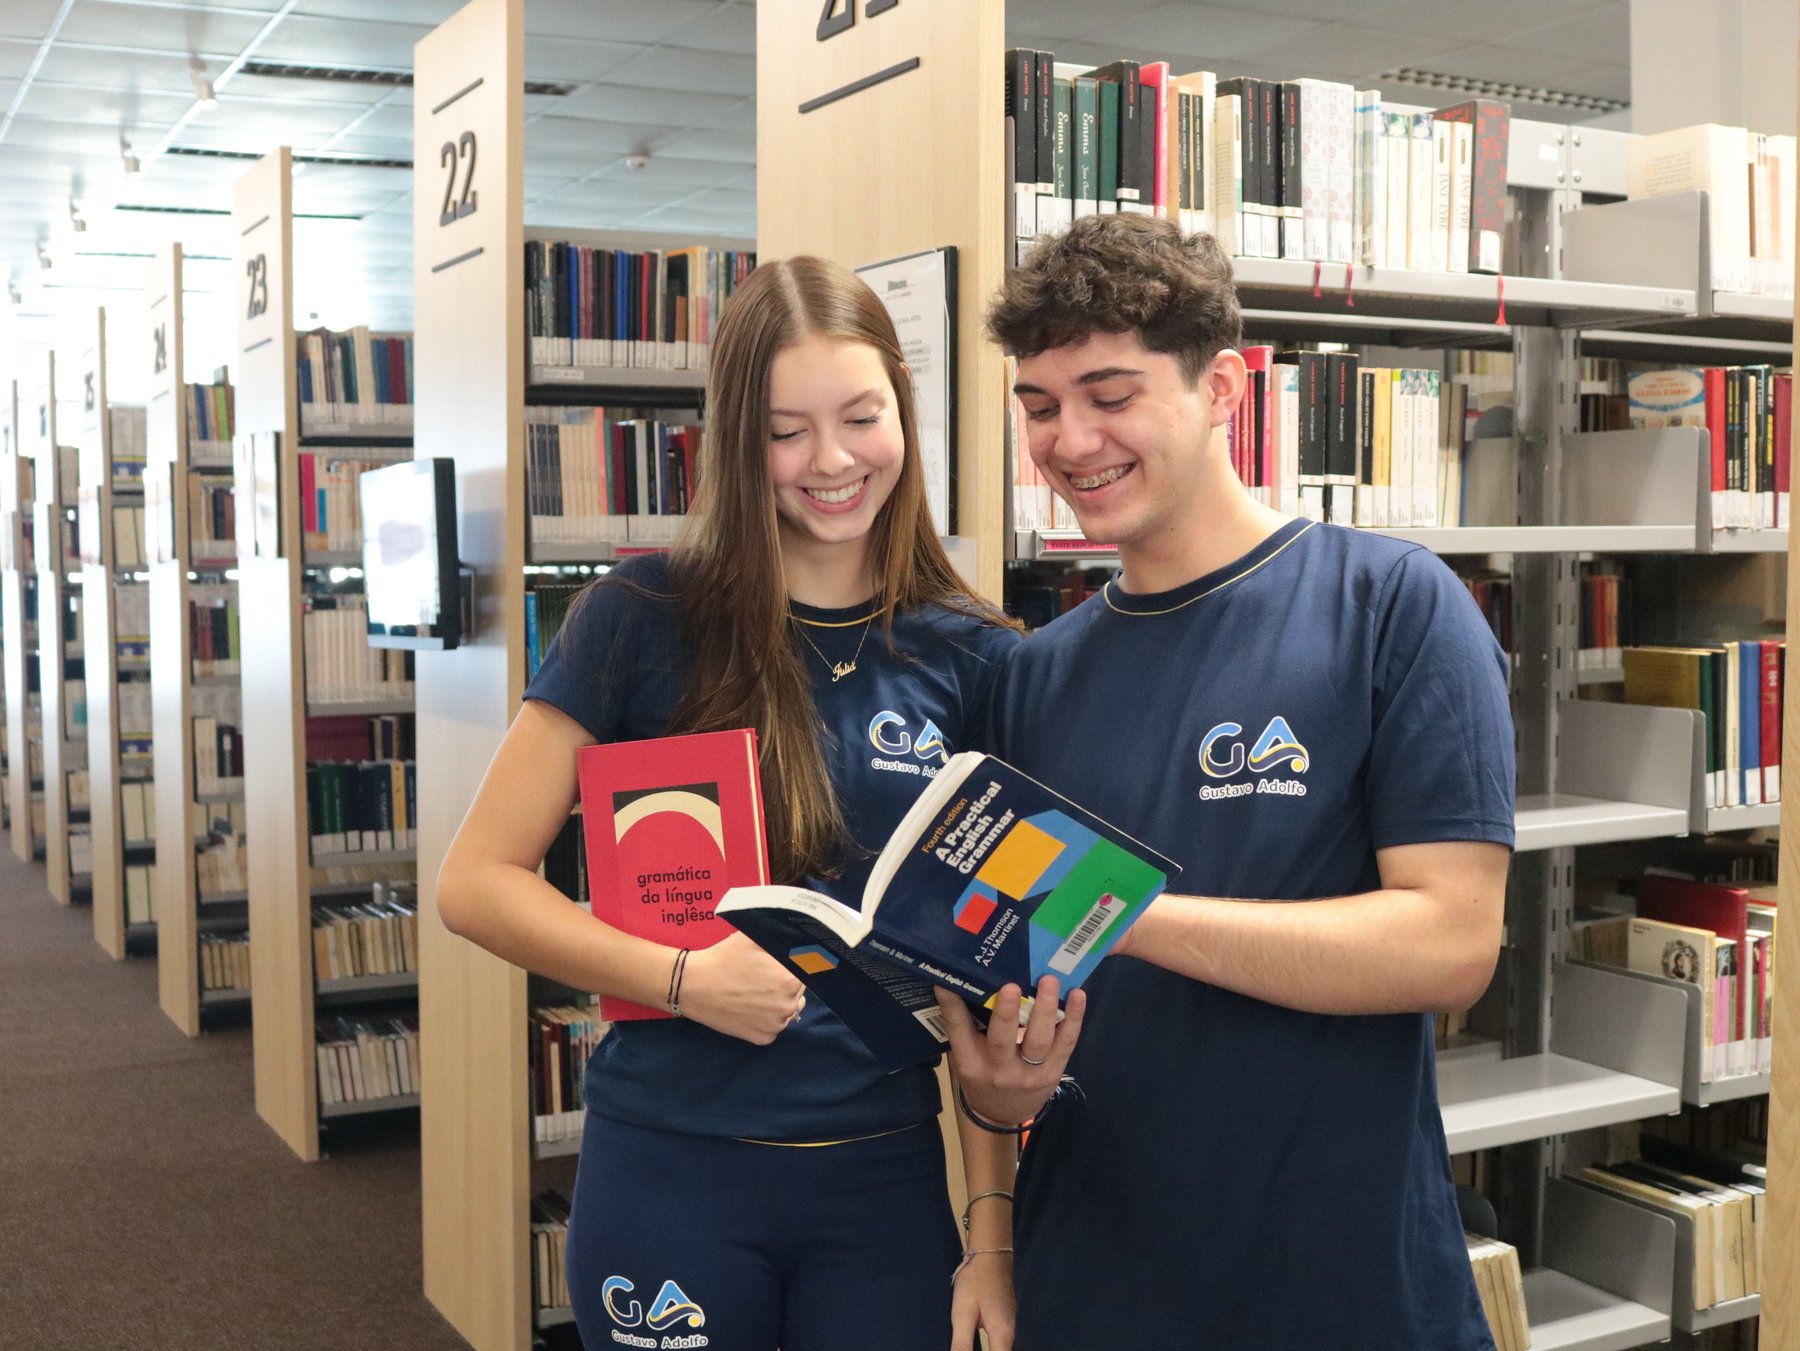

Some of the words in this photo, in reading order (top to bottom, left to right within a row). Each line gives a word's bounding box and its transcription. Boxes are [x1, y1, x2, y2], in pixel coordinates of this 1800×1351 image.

[1057, 111, 1069, 154] Emma
[1082, 112, 1094, 155] Emma
[439, 130, 478, 228] 22
[246, 254, 268, 320] 23
[868, 710, 950, 763] GA
[1199, 716, 1310, 778] GA
[872, 758, 920, 774] Gustavo
[1200, 783, 1254, 800] Gustavo
[1256, 778, 1307, 796] Adolfo
[922, 824, 946, 854] Fourth
[944, 798, 968, 826] edition
[936, 847, 952, 862] A
[944, 780, 1002, 846] Practical
[946, 815, 994, 868] English
[958, 808, 1015, 874] Grammar
[637, 866, 711, 888] gramática
[642, 889, 660, 904] da
[666, 886, 712, 905] língua
[661, 906, 714, 926] inglêsa
[983, 908, 1014, 945] Thomson
[992, 914, 1020, 950] Martinet
[602, 1275, 706, 1331] GA
[612, 1329, 658, 1348] Gustavo
[661, 1334, 709, 1350] Adolfo
